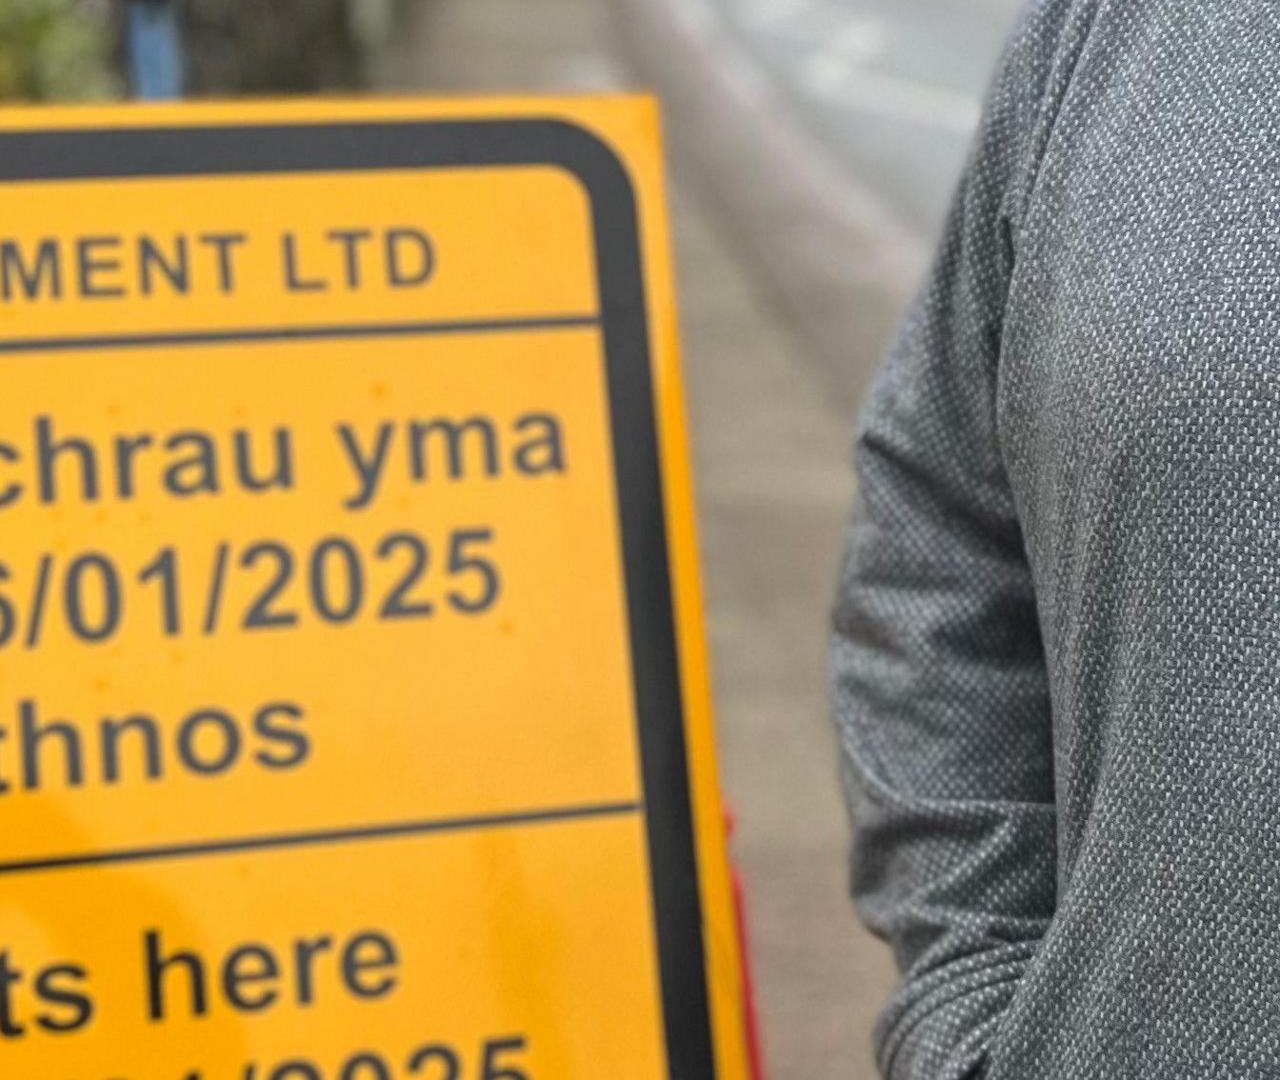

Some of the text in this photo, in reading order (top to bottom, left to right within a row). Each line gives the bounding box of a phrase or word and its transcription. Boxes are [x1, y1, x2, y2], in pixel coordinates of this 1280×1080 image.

[283, 228, 435, 291] LTD
[337, 413, 566, 511] yma
[142, 928, 399, 1023] here
